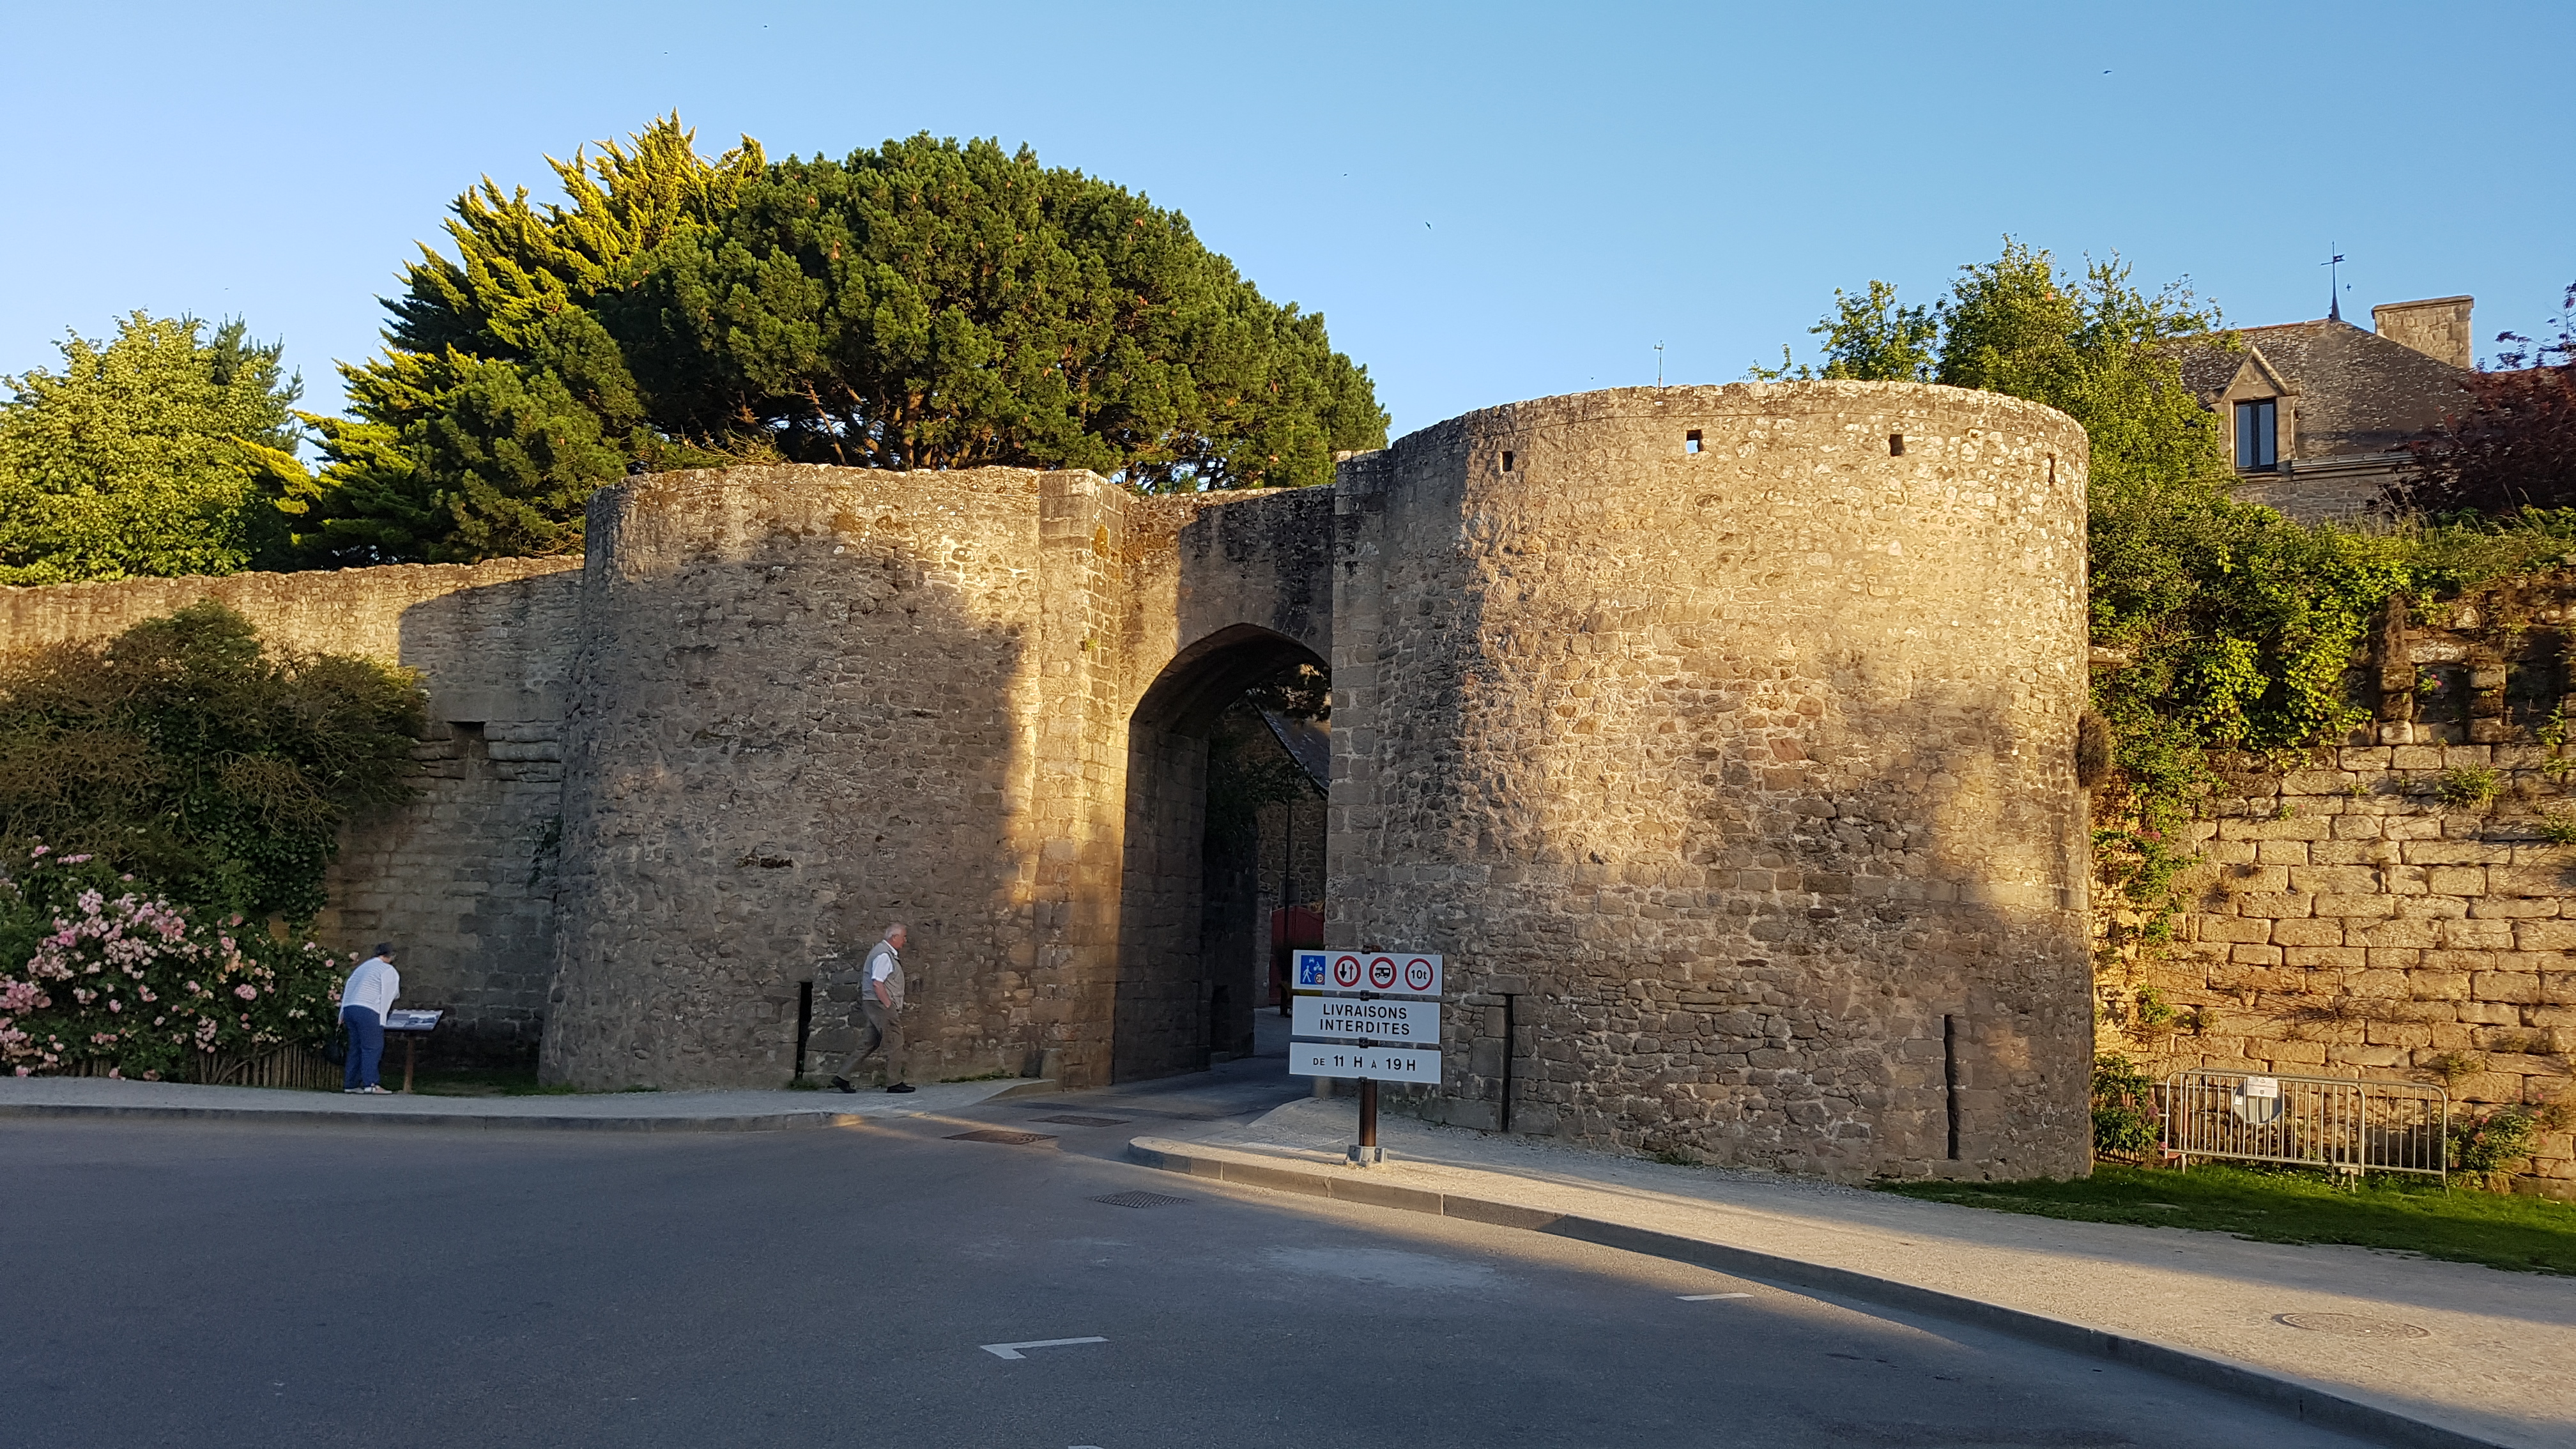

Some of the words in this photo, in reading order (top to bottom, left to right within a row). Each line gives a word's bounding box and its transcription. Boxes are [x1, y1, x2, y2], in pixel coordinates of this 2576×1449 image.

[1411, 970, 1427, 979] 10t
[1323, 1004, 1407, 1019] LIVRAISONS
[1320, 1019, 1409, 1035] INTERDITES
[1333, 1055, 1344, 1066] 11
[1354, 1056, 1362, 1068] H
[1371, 1059, 1377, 1069] A
[1386, 1058, 1402, 1070] 19
[1407, 1059, 1415, 1071] H
